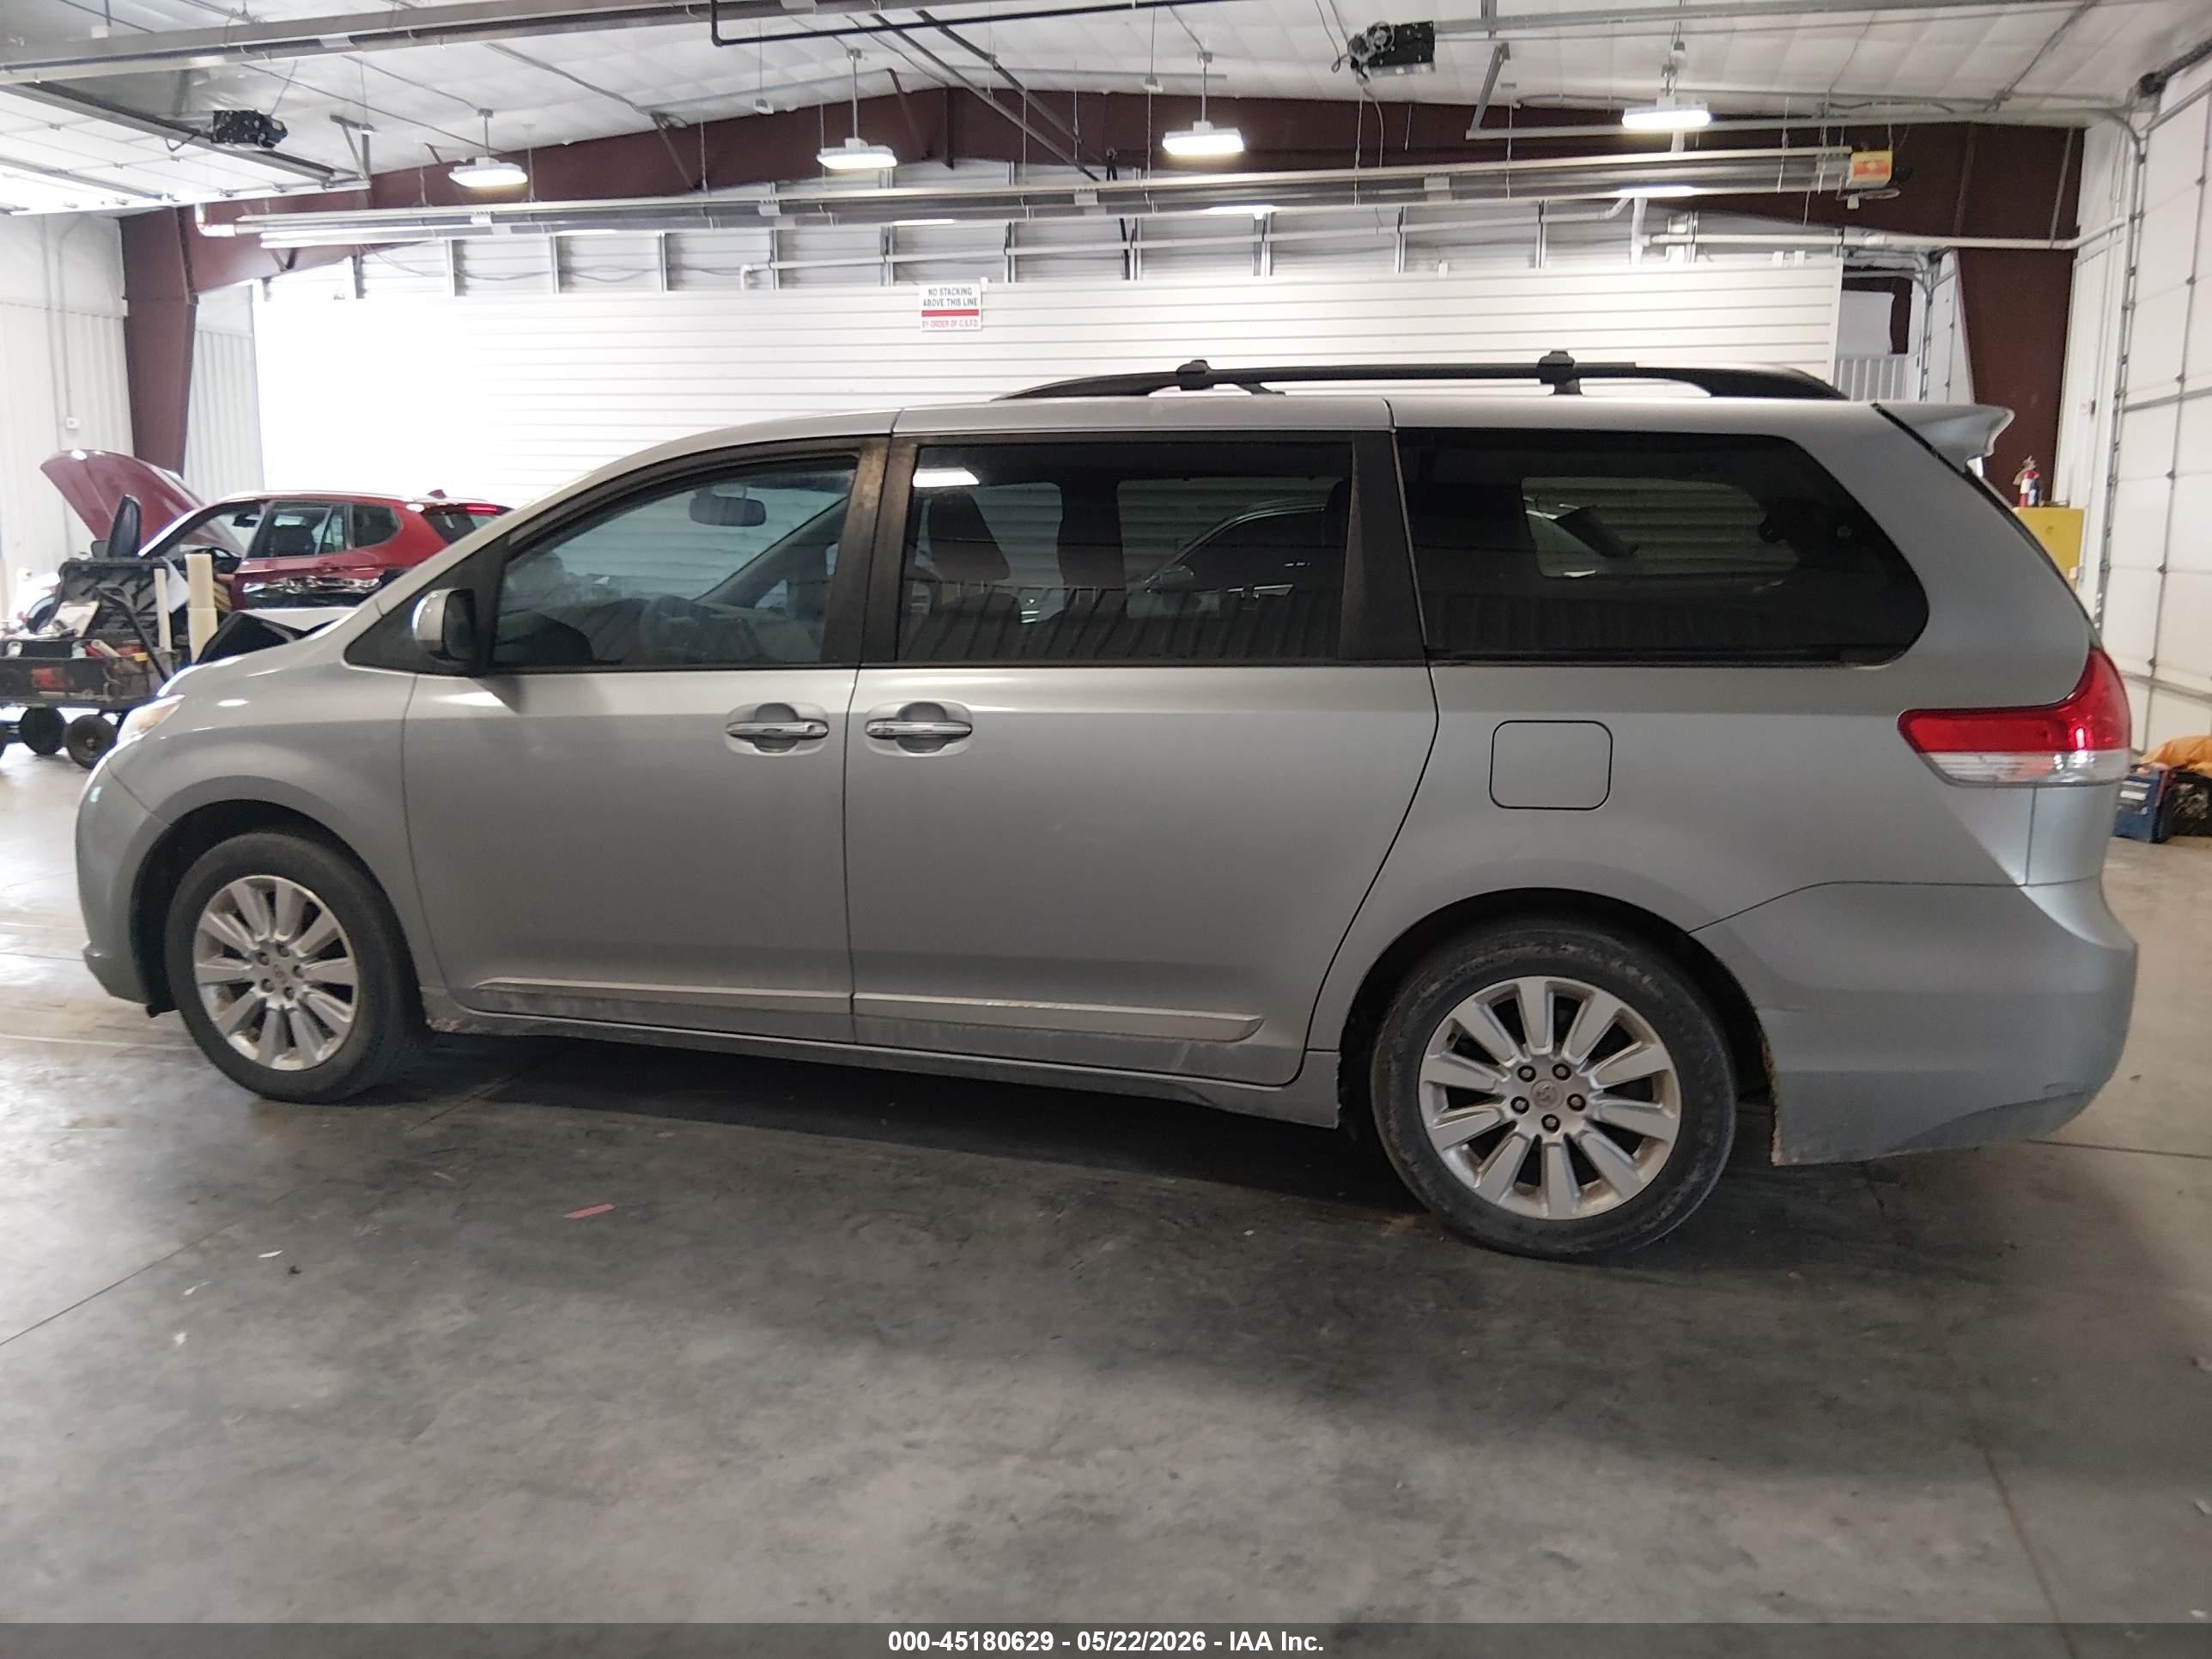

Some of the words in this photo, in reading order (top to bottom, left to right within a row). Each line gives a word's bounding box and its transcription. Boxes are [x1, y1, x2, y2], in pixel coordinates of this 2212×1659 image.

[928, 288, 938, 296] NO
[939, 287, 972, 296] STACKING
[923, 298, 944, 307] ABOVE
[946, 298, 962, 307] THIS
[963, 297, 977, 307] LINE
[930, 319, 949, 328] ORDER
